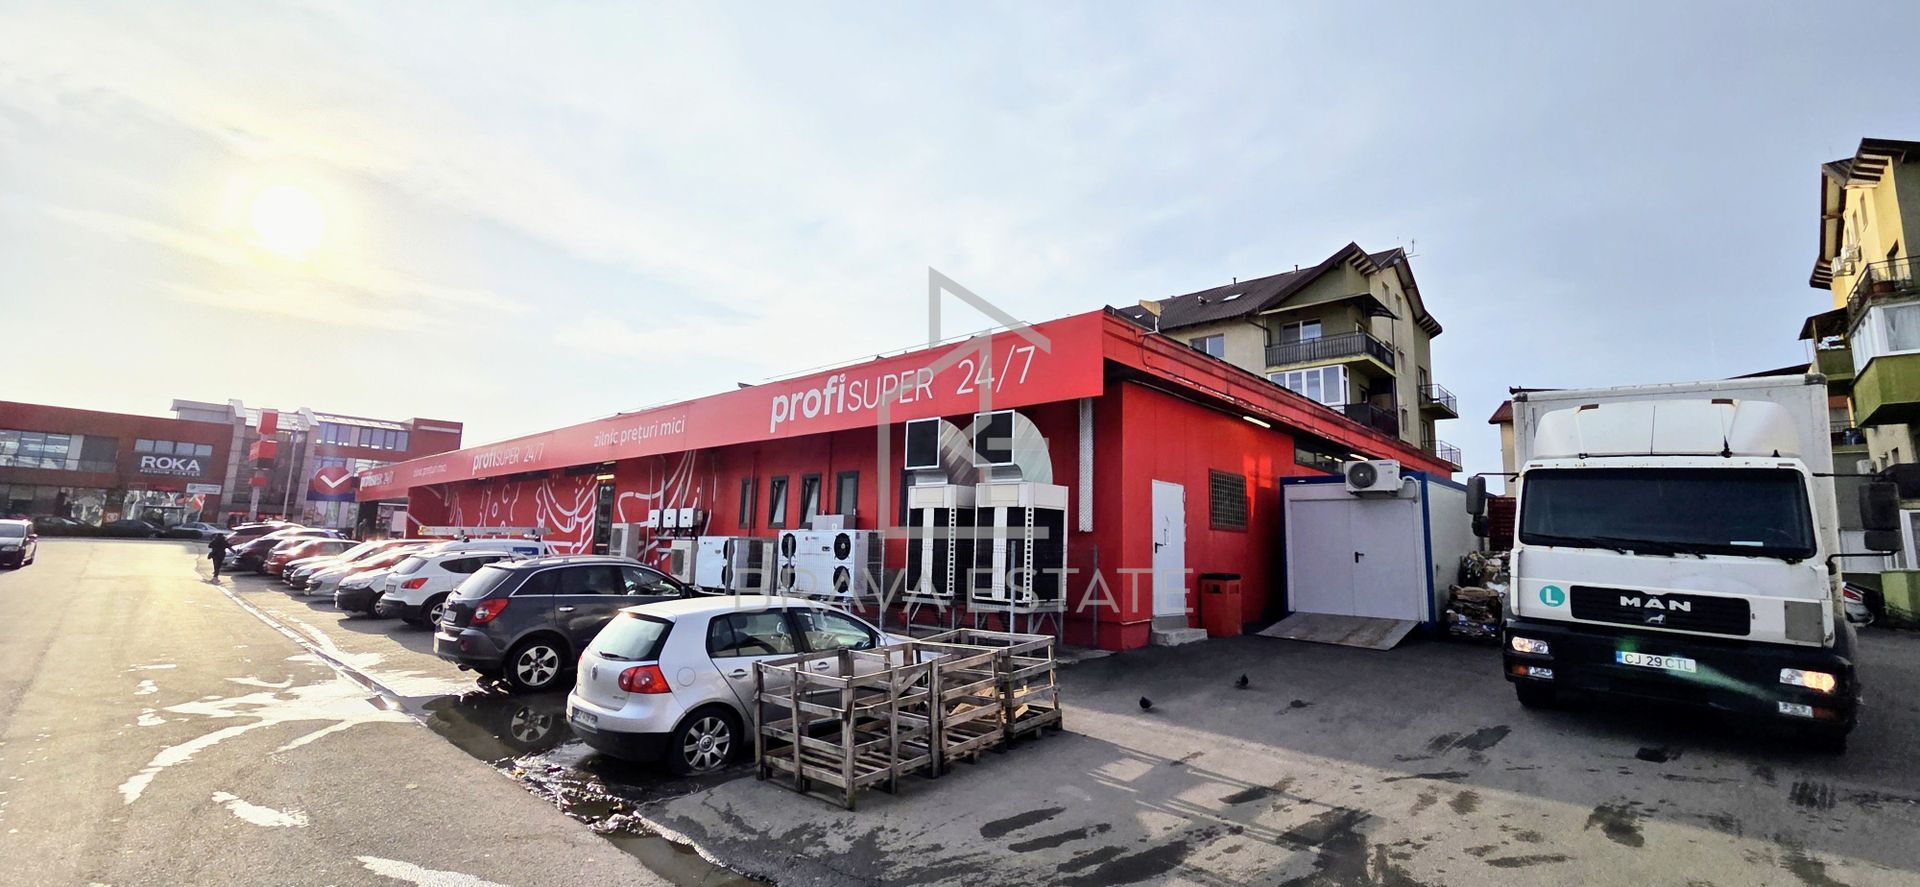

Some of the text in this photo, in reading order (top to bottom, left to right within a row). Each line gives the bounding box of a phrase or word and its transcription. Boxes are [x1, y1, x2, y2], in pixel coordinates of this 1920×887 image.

[957, 344, 1036, 394] 24/7
[593, 428, 619, 447] zilnic
[660, 415, 685, 436] mici
[140, 455, 200, 471] ROKA
[1545, 587, 1559, 604] L
[1620, 595, 1692, 612] MAN
[1624, 653, 1692, 671] CJ 29 CTL
